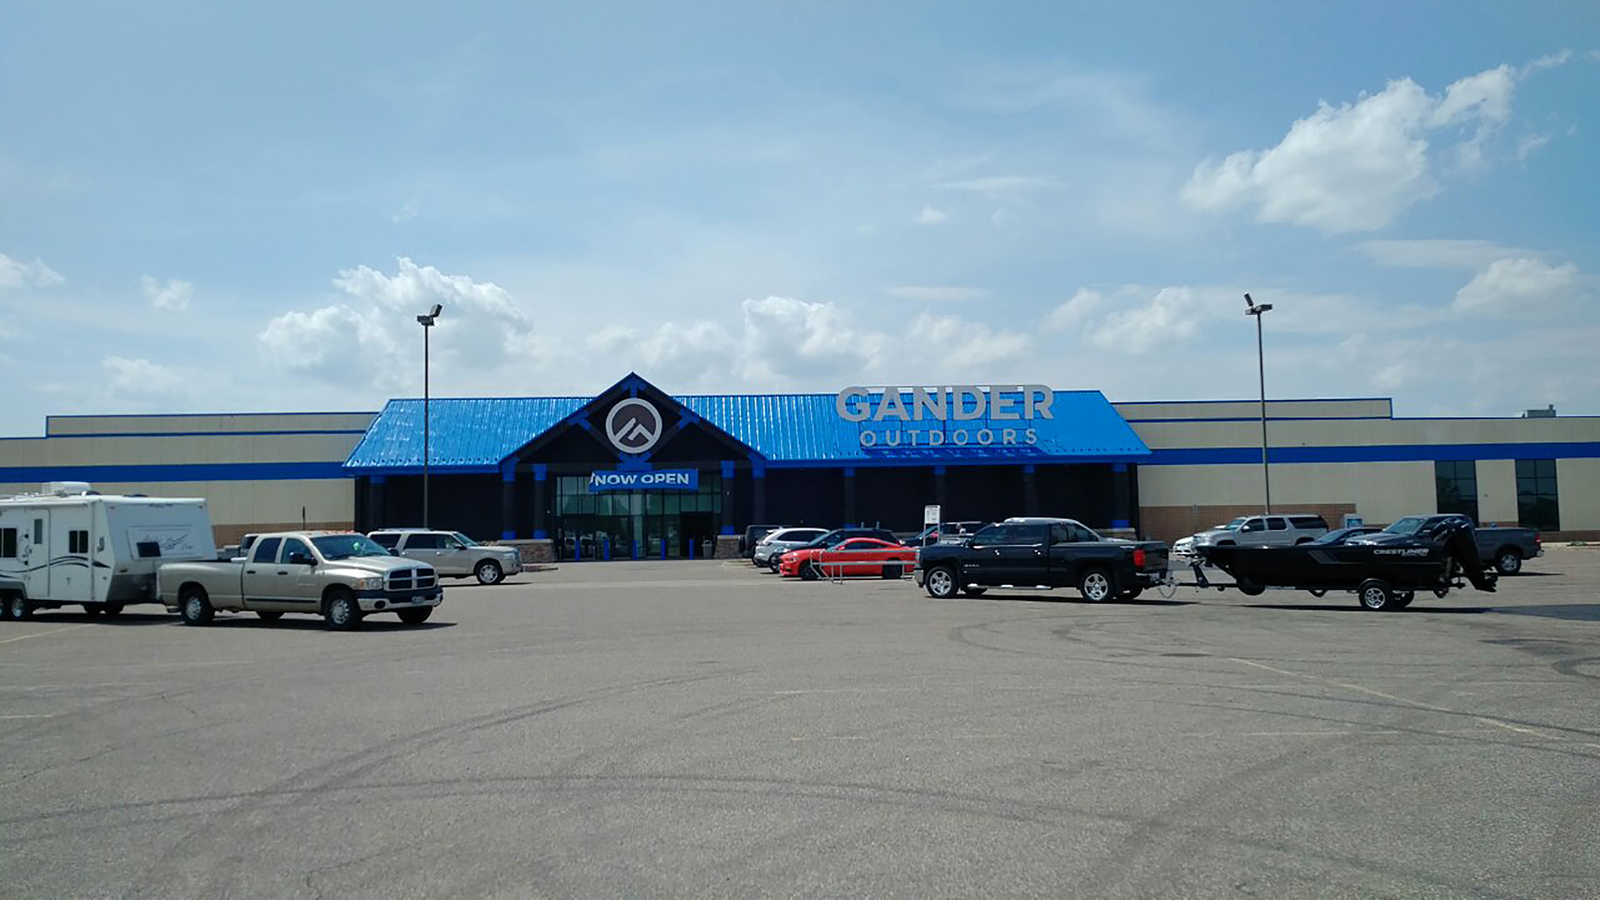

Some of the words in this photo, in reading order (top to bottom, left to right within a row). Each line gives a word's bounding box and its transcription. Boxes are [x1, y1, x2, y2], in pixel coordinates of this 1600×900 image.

[835, 384, 1054, 422] GANDER
[859, 428, 1038, 447] OUTDOORS
[592, 474, 638, 486] NOW
[640, 473, 689, 485] OPEN
